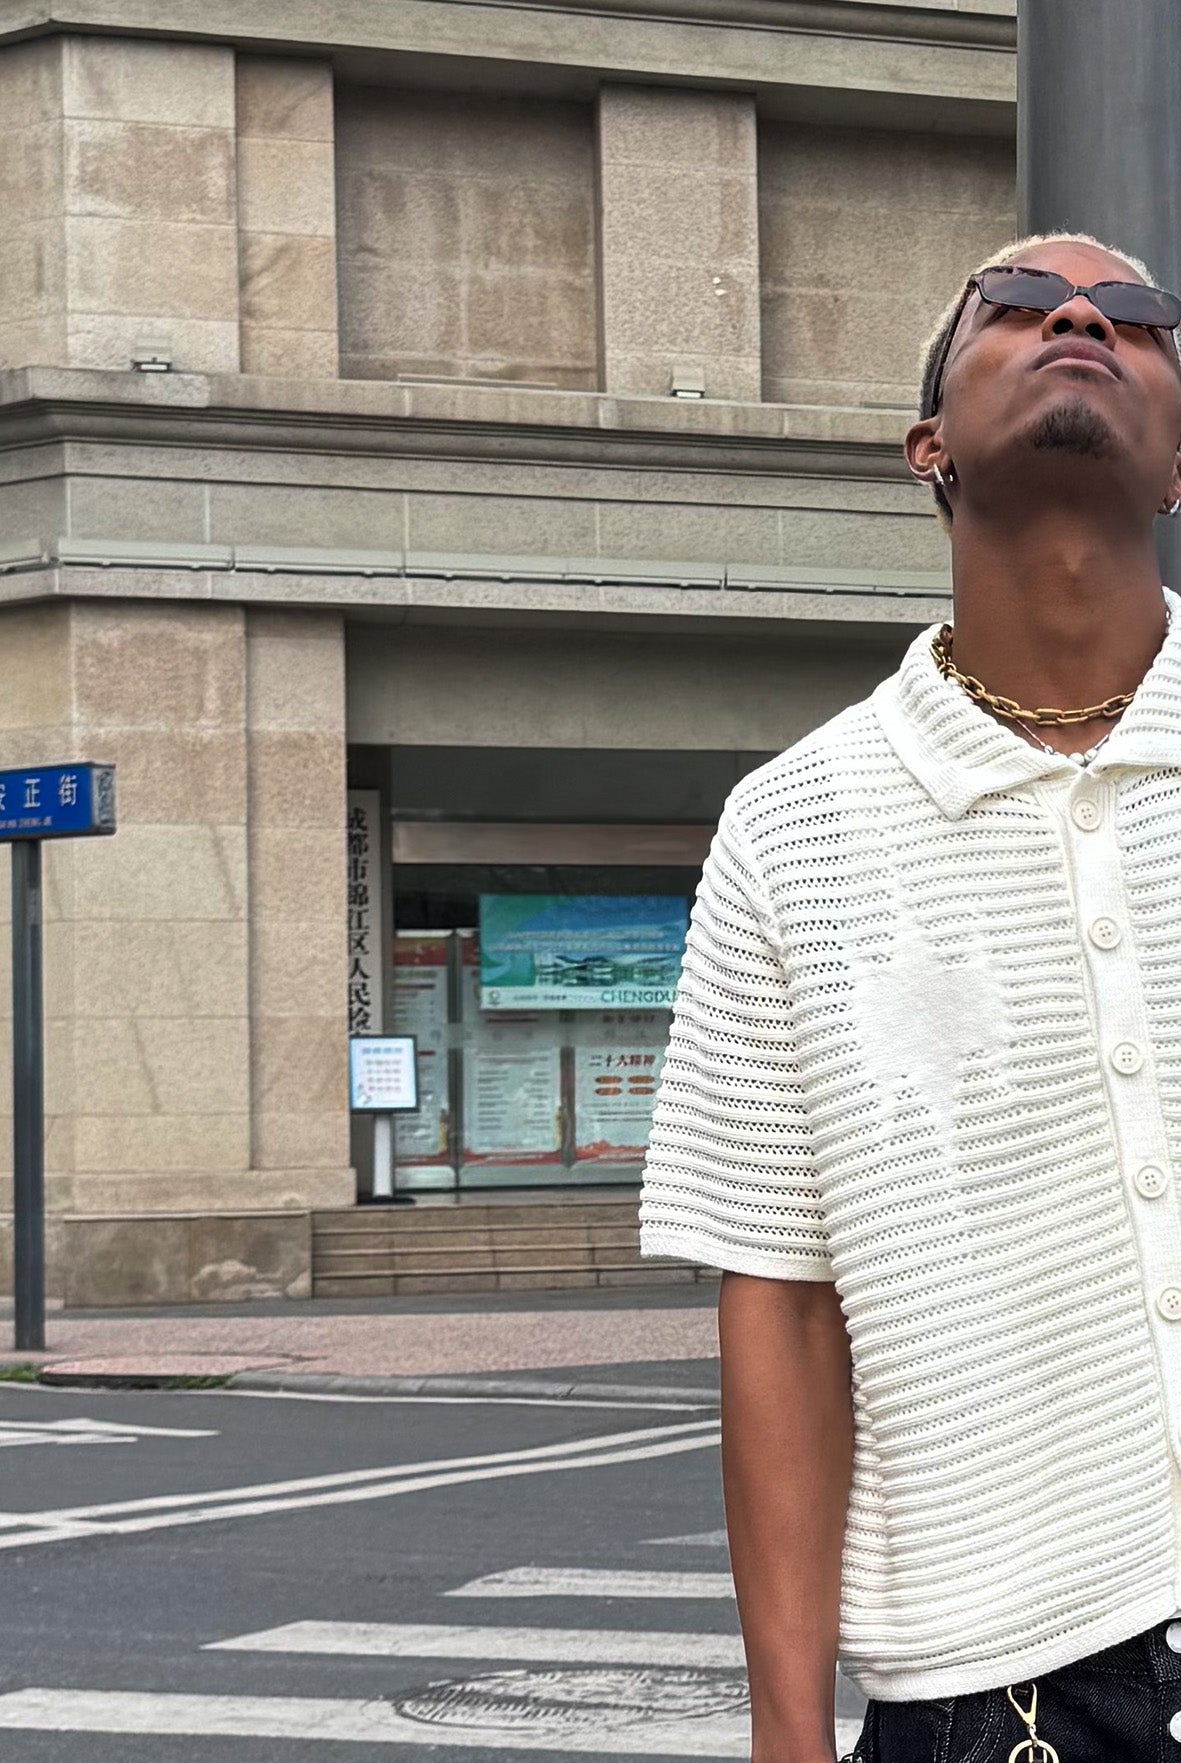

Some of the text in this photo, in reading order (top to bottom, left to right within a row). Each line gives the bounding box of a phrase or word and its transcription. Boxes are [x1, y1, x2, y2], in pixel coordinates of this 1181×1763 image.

[348, 806, 371, 1034] 成都市锦江区人民检
